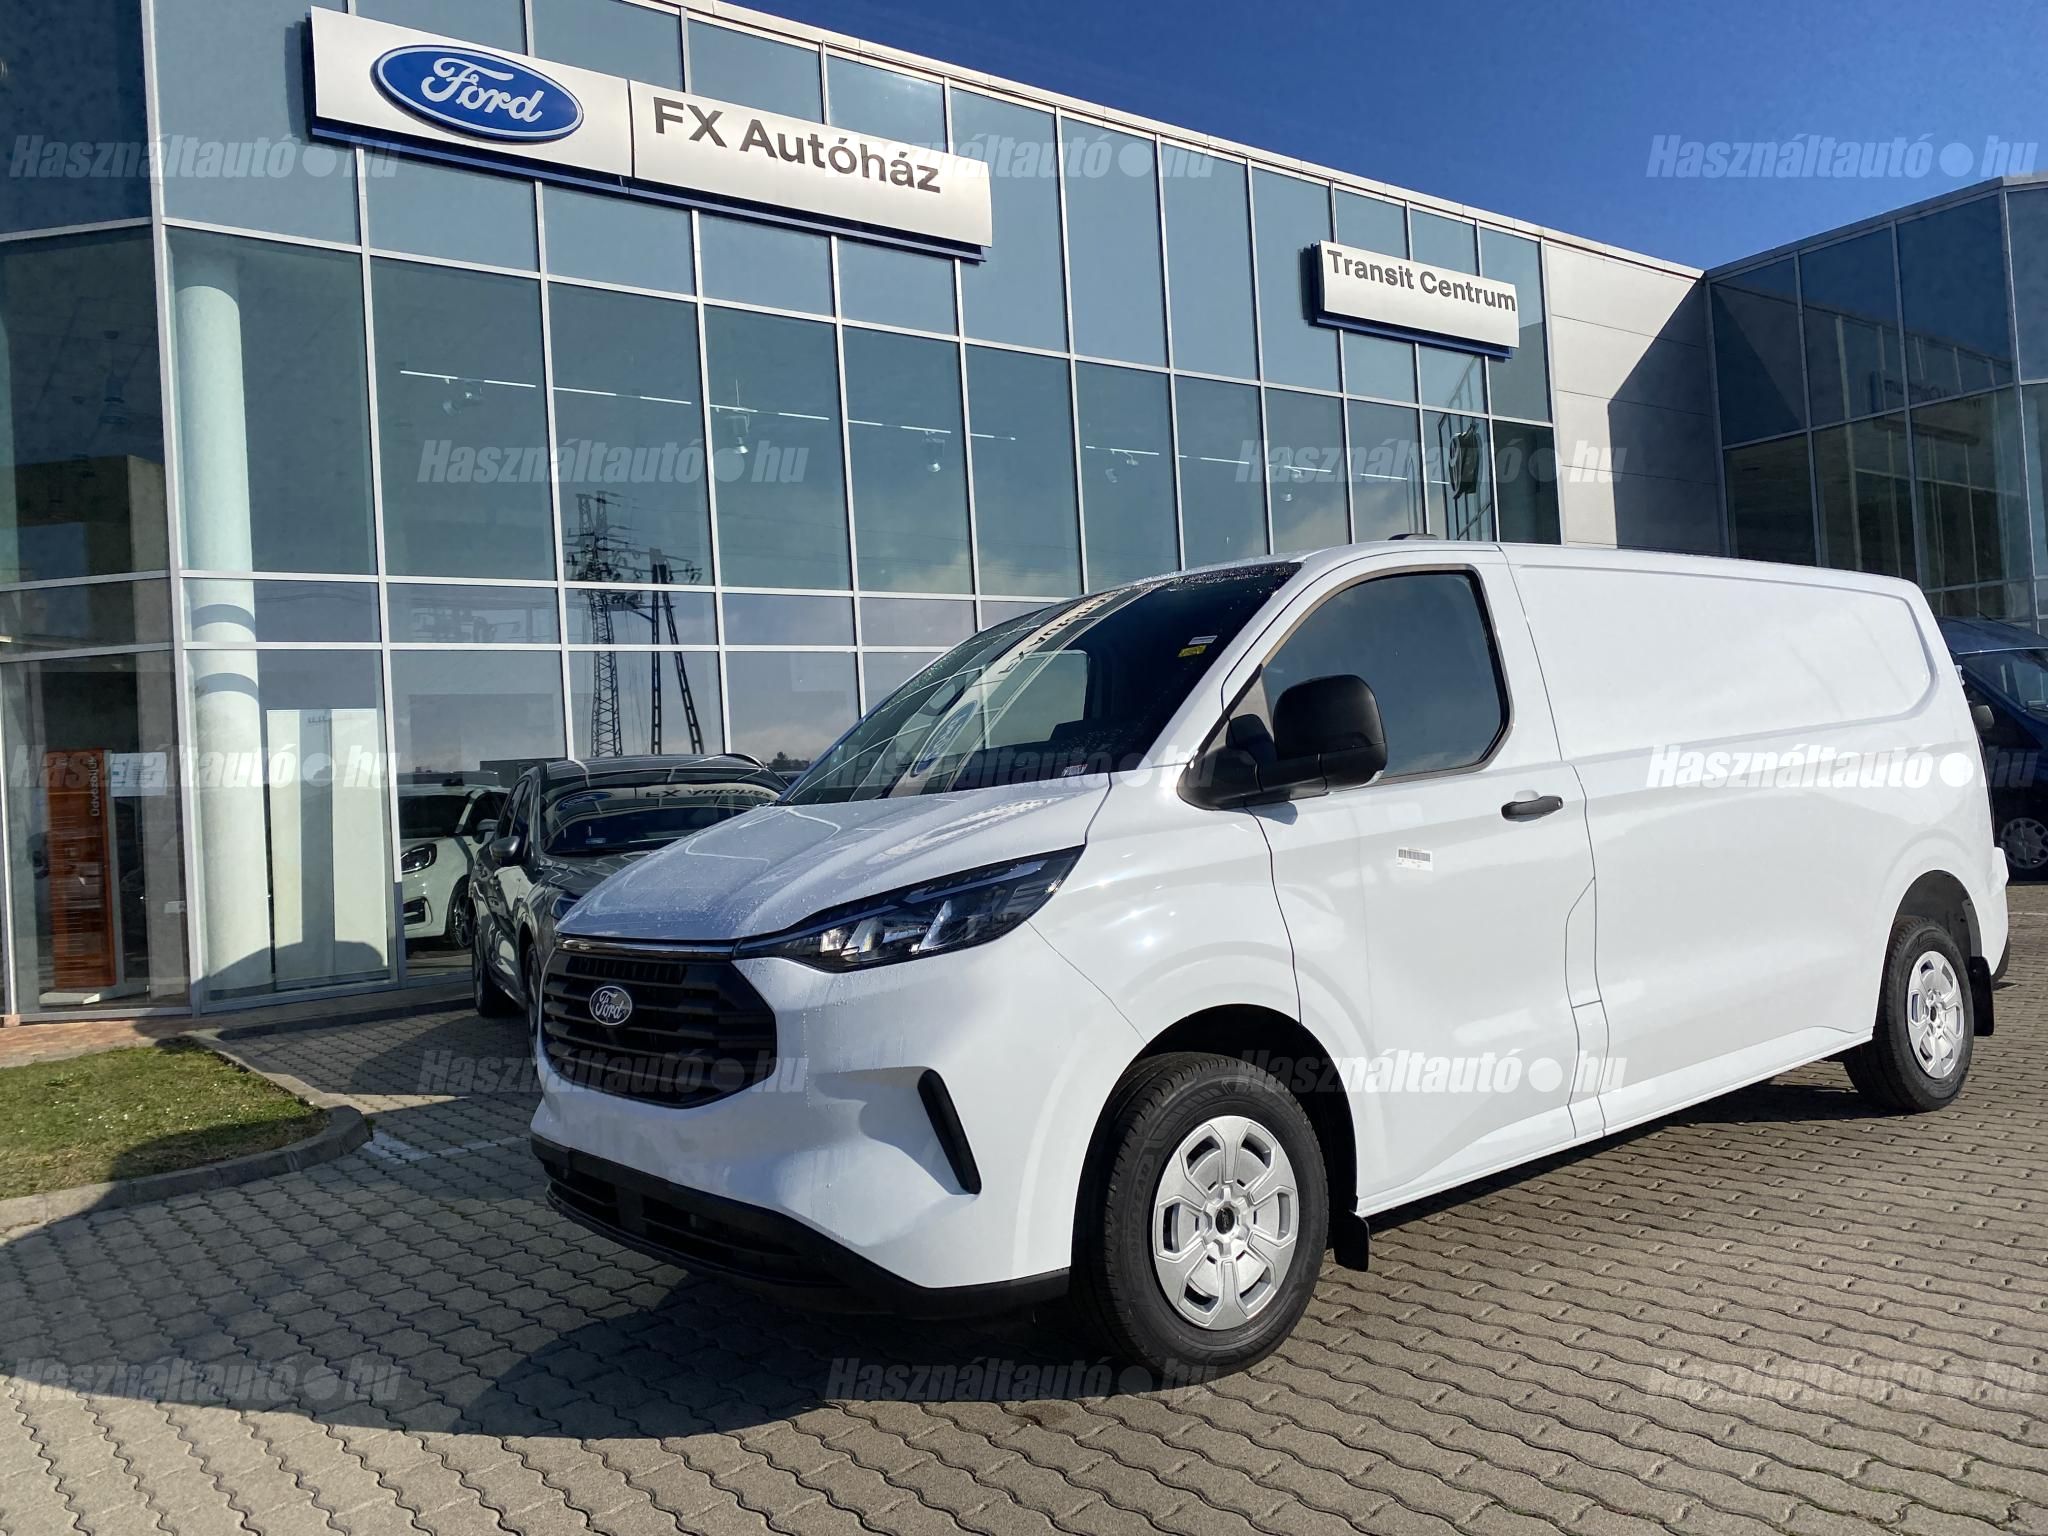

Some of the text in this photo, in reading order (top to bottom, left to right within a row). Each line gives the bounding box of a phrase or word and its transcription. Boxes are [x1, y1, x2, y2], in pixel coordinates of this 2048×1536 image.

[420, 57, 545, 123] Ford
[653, 96, 942, 194] FX Autóház
[1327, 249, 1517, 312] Transit Centrum
[595, 990, 624, 1019] Ford
